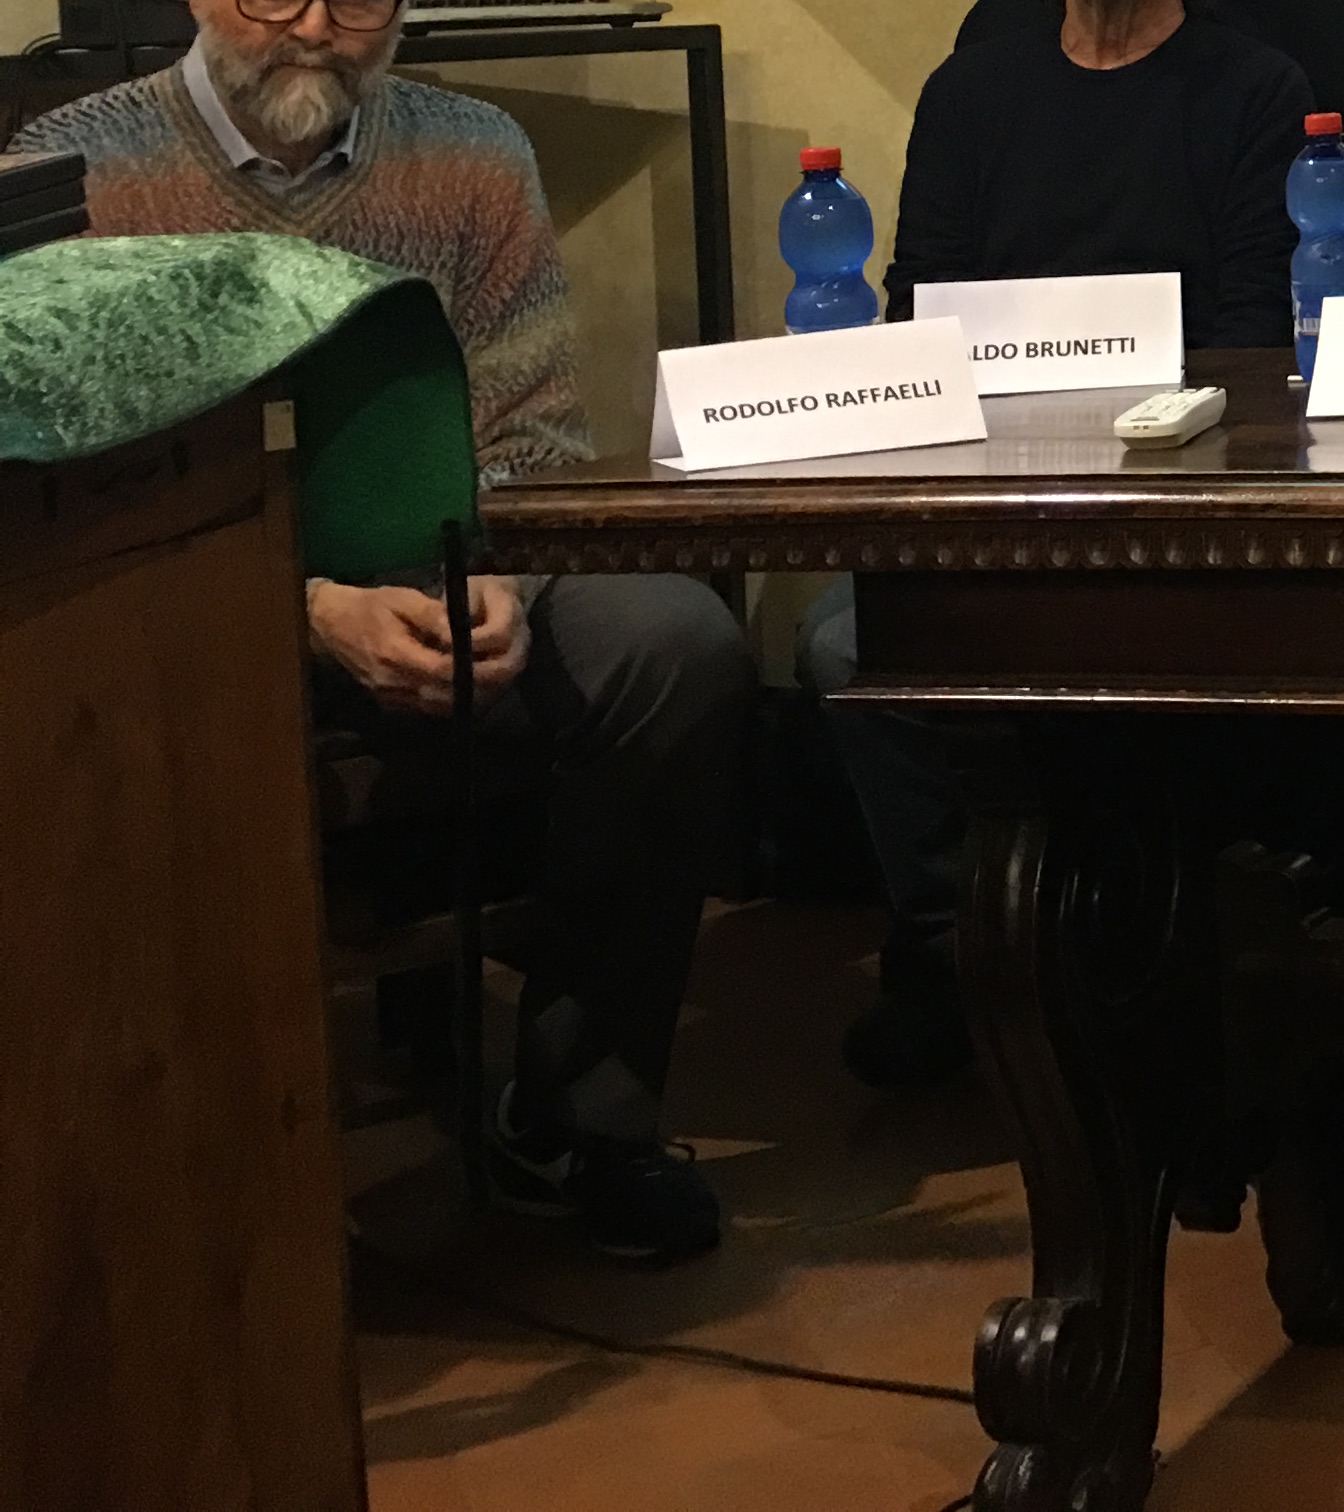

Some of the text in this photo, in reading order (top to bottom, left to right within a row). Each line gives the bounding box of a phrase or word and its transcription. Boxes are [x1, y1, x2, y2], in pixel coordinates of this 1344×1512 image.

[967, 337, 1135, 362] LDO BRUNETTI
[703, 379, 942, 423] RODOLFO RAFFAELLI
